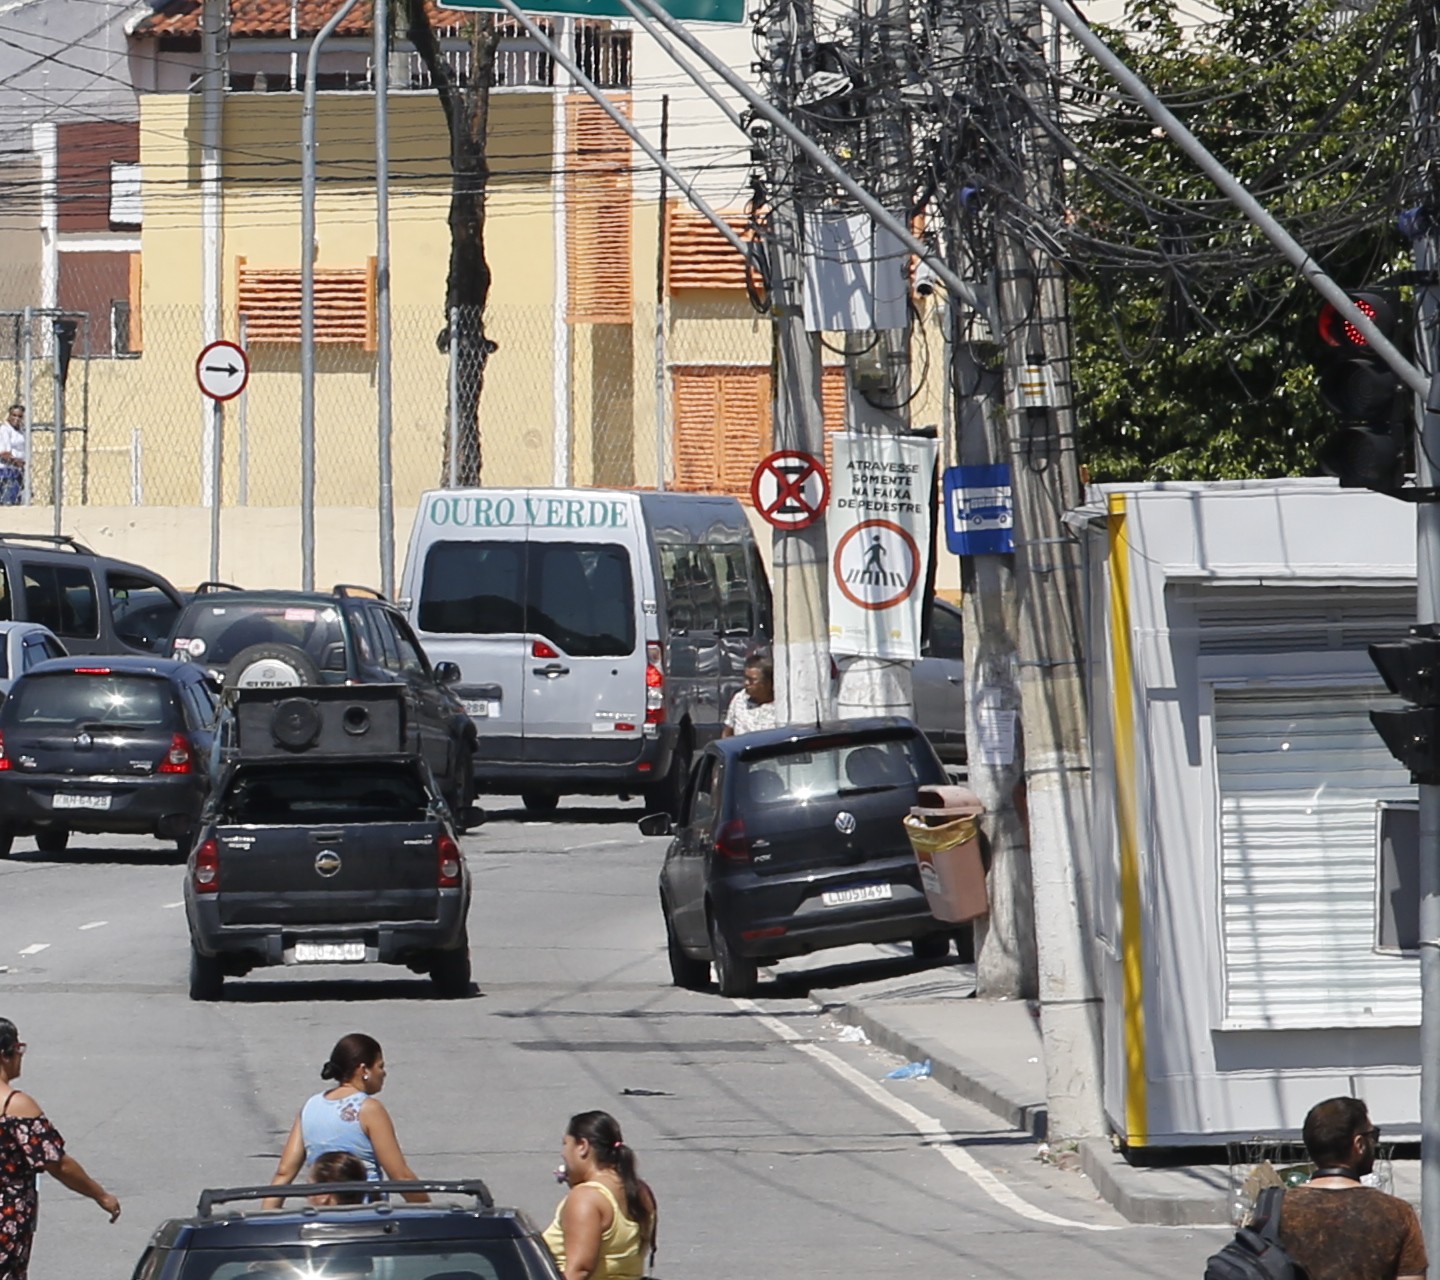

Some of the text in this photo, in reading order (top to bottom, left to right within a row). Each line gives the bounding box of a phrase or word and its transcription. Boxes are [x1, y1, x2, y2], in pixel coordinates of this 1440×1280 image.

[846, 460, 919, 473] ATRAVESSE
[852, 475, 913, 486] SOMENTE
[851, 487, 911, 500] NA FAIXA
[430, 497, 629, 528] OURO VERDE
[838, 498, 922, 514] DE PEDESTRE
